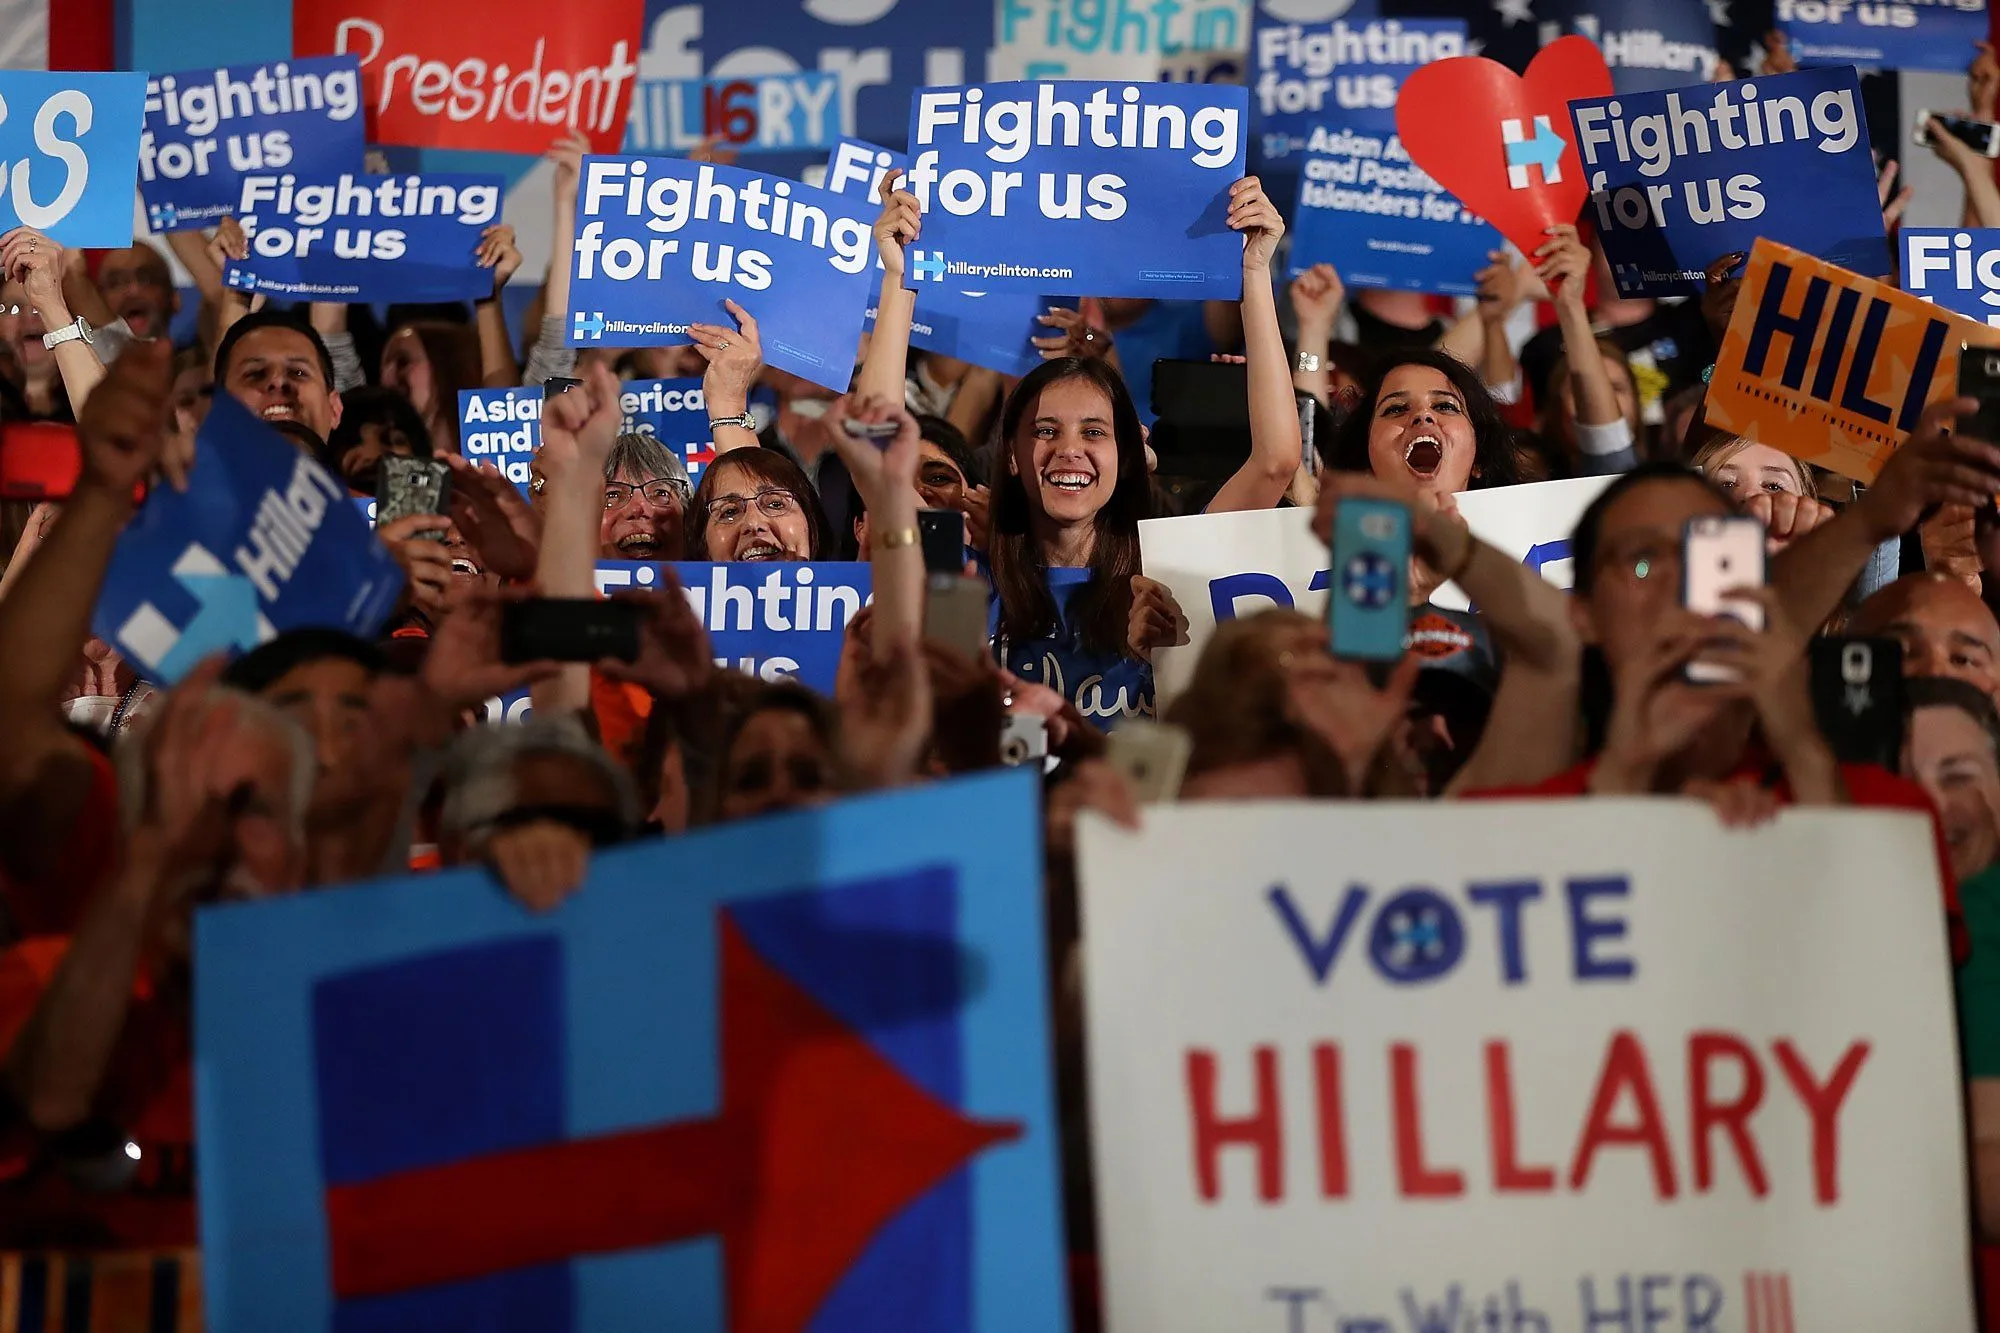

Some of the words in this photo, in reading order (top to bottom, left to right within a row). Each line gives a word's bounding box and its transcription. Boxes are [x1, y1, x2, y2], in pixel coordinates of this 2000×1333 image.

[1857, 4, 1918, 28] us
[335, 18, 637, 132] President
[1258, 20, 1465, 76] Fighting
[144, 63, 360, 136] Fighting
[1257, 72, 1332, 115] for
[1336, 74, 1398, 109] us
[917, 85, 1239, 169] Fighting
[1307, 126, 1381, 160] Asian
[1575, 83, 1859, 177] Fighting
[139, 130, 218, 182] for
[228, 129, 294, 172] us
[1304, 157, 1361, 184] and
[239, 174, 498, 225] Fighting
[908, 150, 1023, 216] for
[1039, 173, 1128, 221] us
[1302, 180, 1420, 219] Islanders
[1421, 192, 1463, 222] for
[1591, 170, 1673, 231] for
[1684, 173, 1766, 225] us
[239, 215, 325, 258] for
[333, 227, 408, 260] us
[584, 160, 873, 275] Fighting
[575, 221, 678, 280] for
[691, 240, 774, 290] us
[947, 261, 1073, 280] hillaryclinton.com
[465, 392, 544, 424] Asia
[467, 422, 532, 455] and
[1265, 876, 1638, 986] VOTE
[1184, 1029, 1873, 1208] HILLARY
